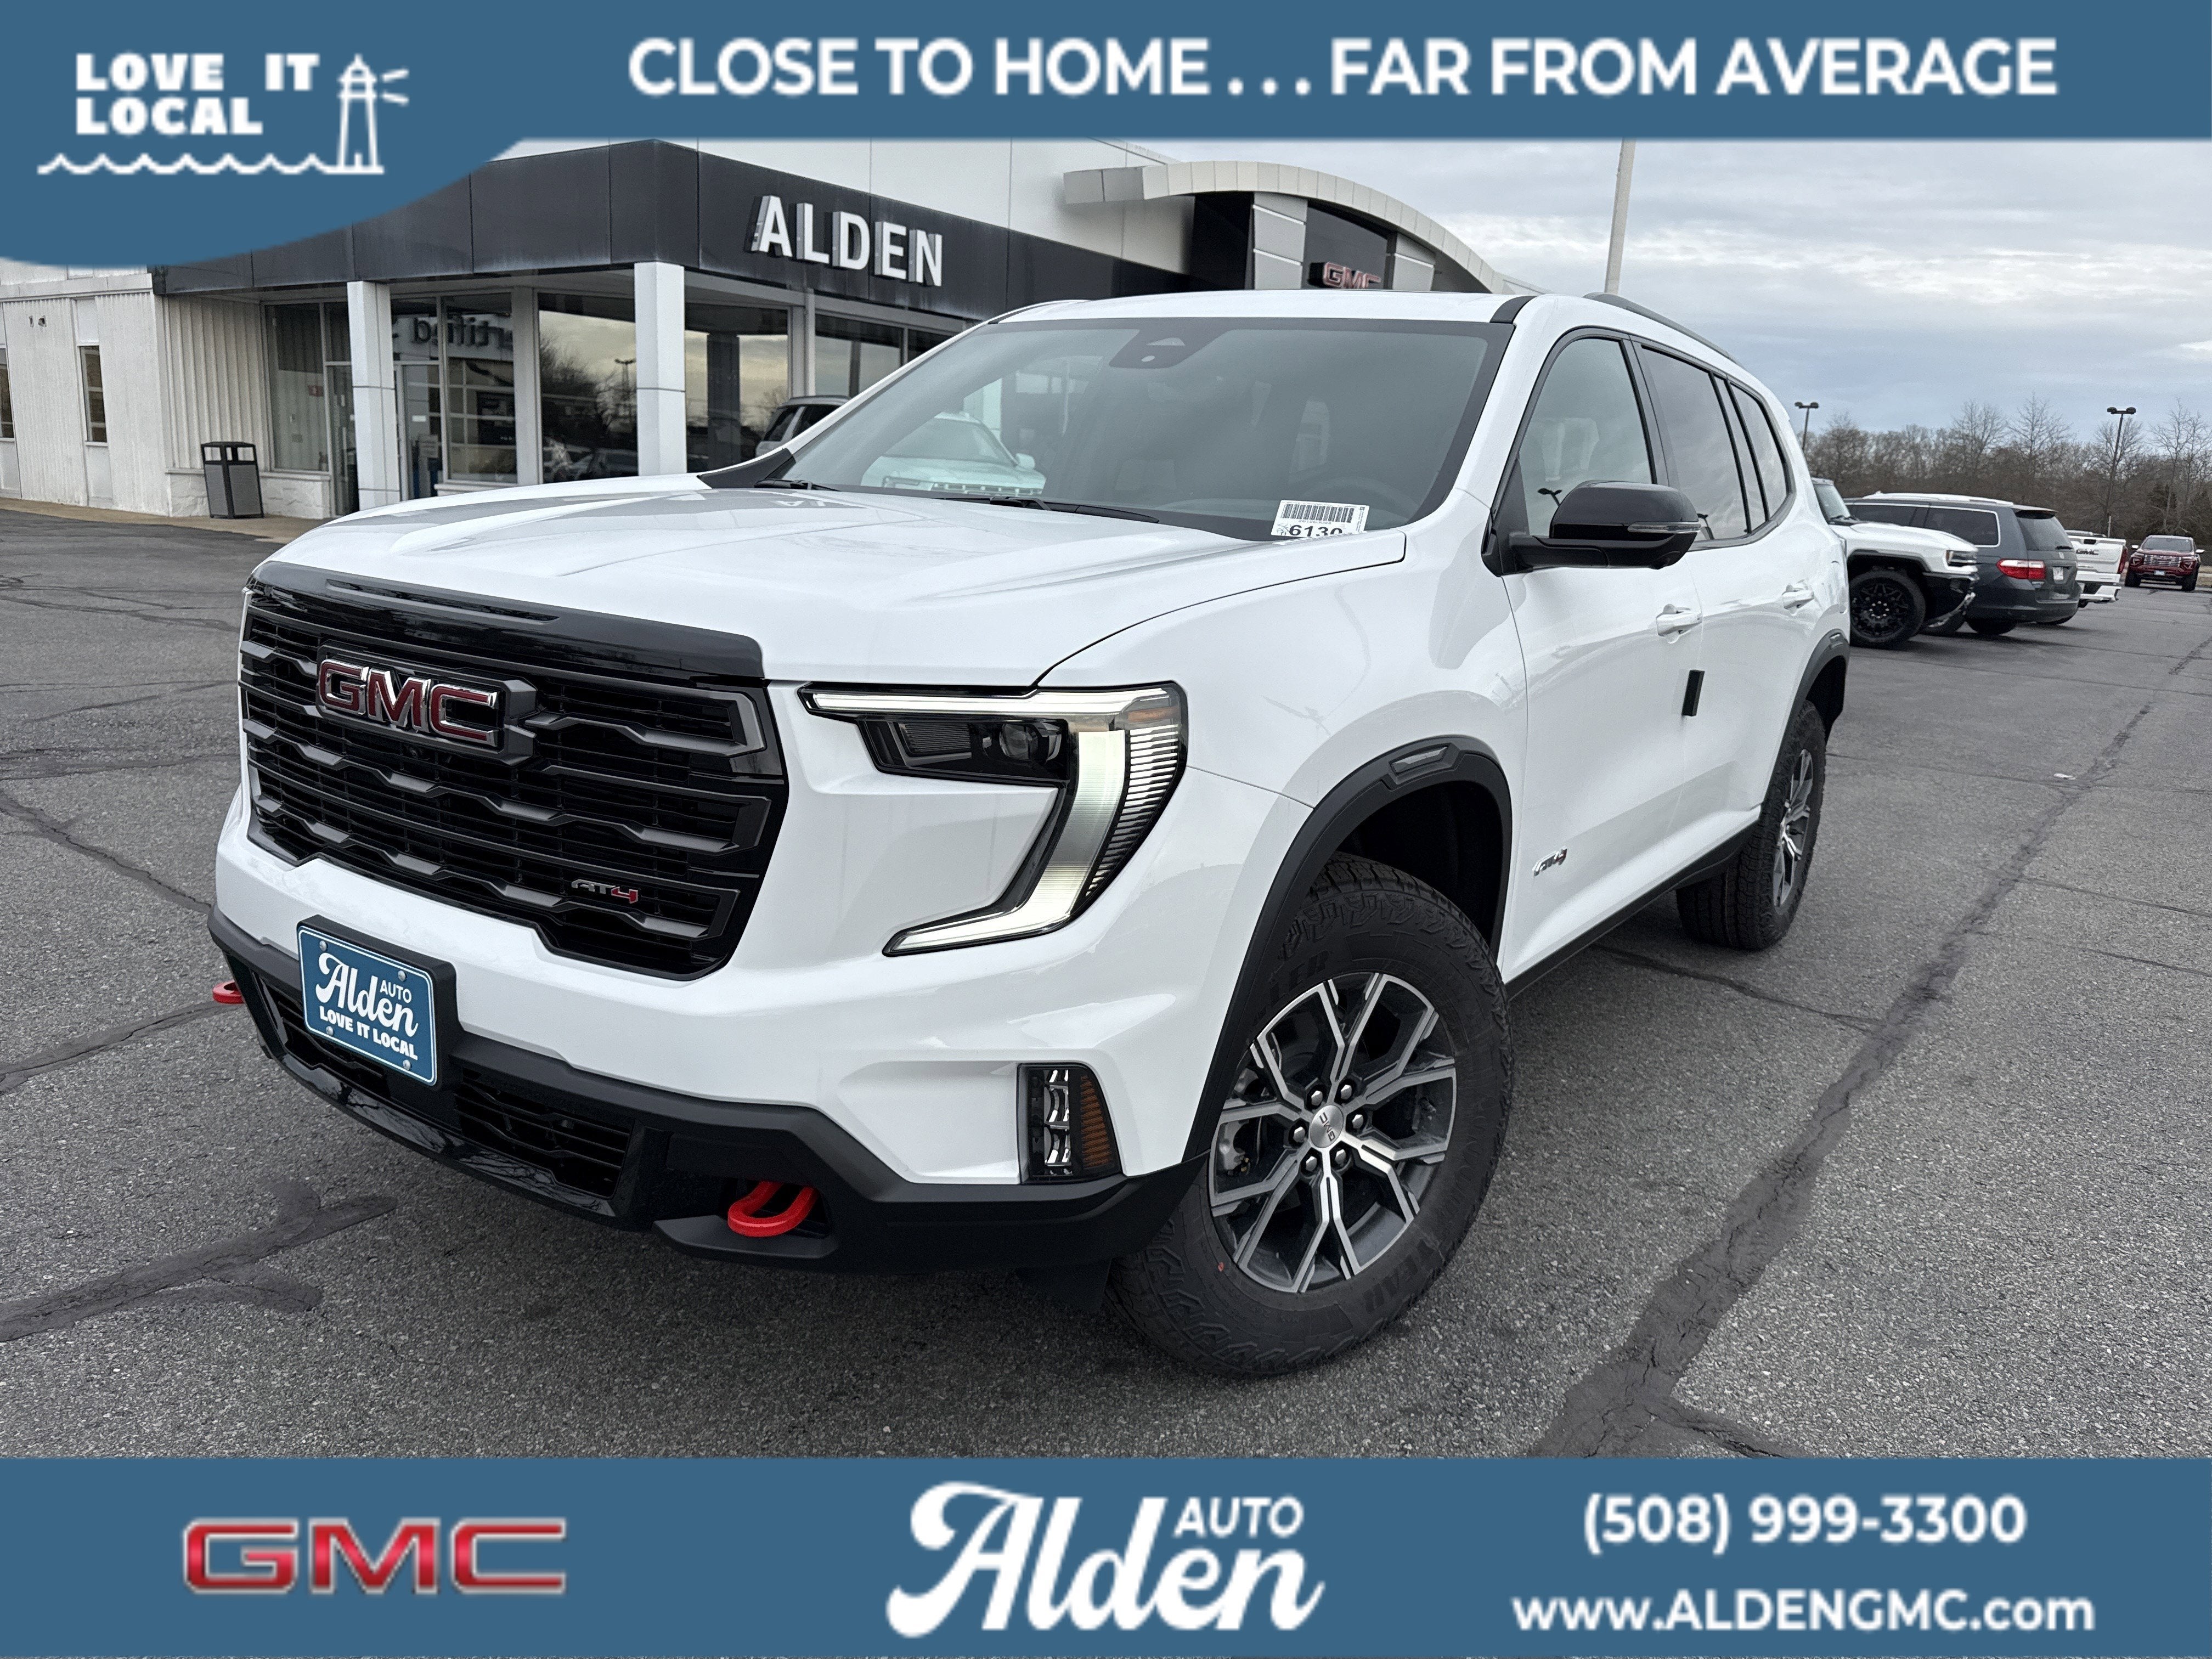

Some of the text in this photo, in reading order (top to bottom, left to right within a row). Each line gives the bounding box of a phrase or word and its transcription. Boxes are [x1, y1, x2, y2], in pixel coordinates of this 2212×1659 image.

[751, 195, 943, 287] ALDEN
[1323, 262, 1382, 289] GMC
[319, 659, 498, 747] GMC
[571, 879, 639, 904] AT4
[315, 952, 419, 1037] Alden
[379, 979, 412, 1004] AUTO
[319, 1005, 418, 1061] LOVE IT LOCAL
[1319, 1110, 1336, 1142] GMC
